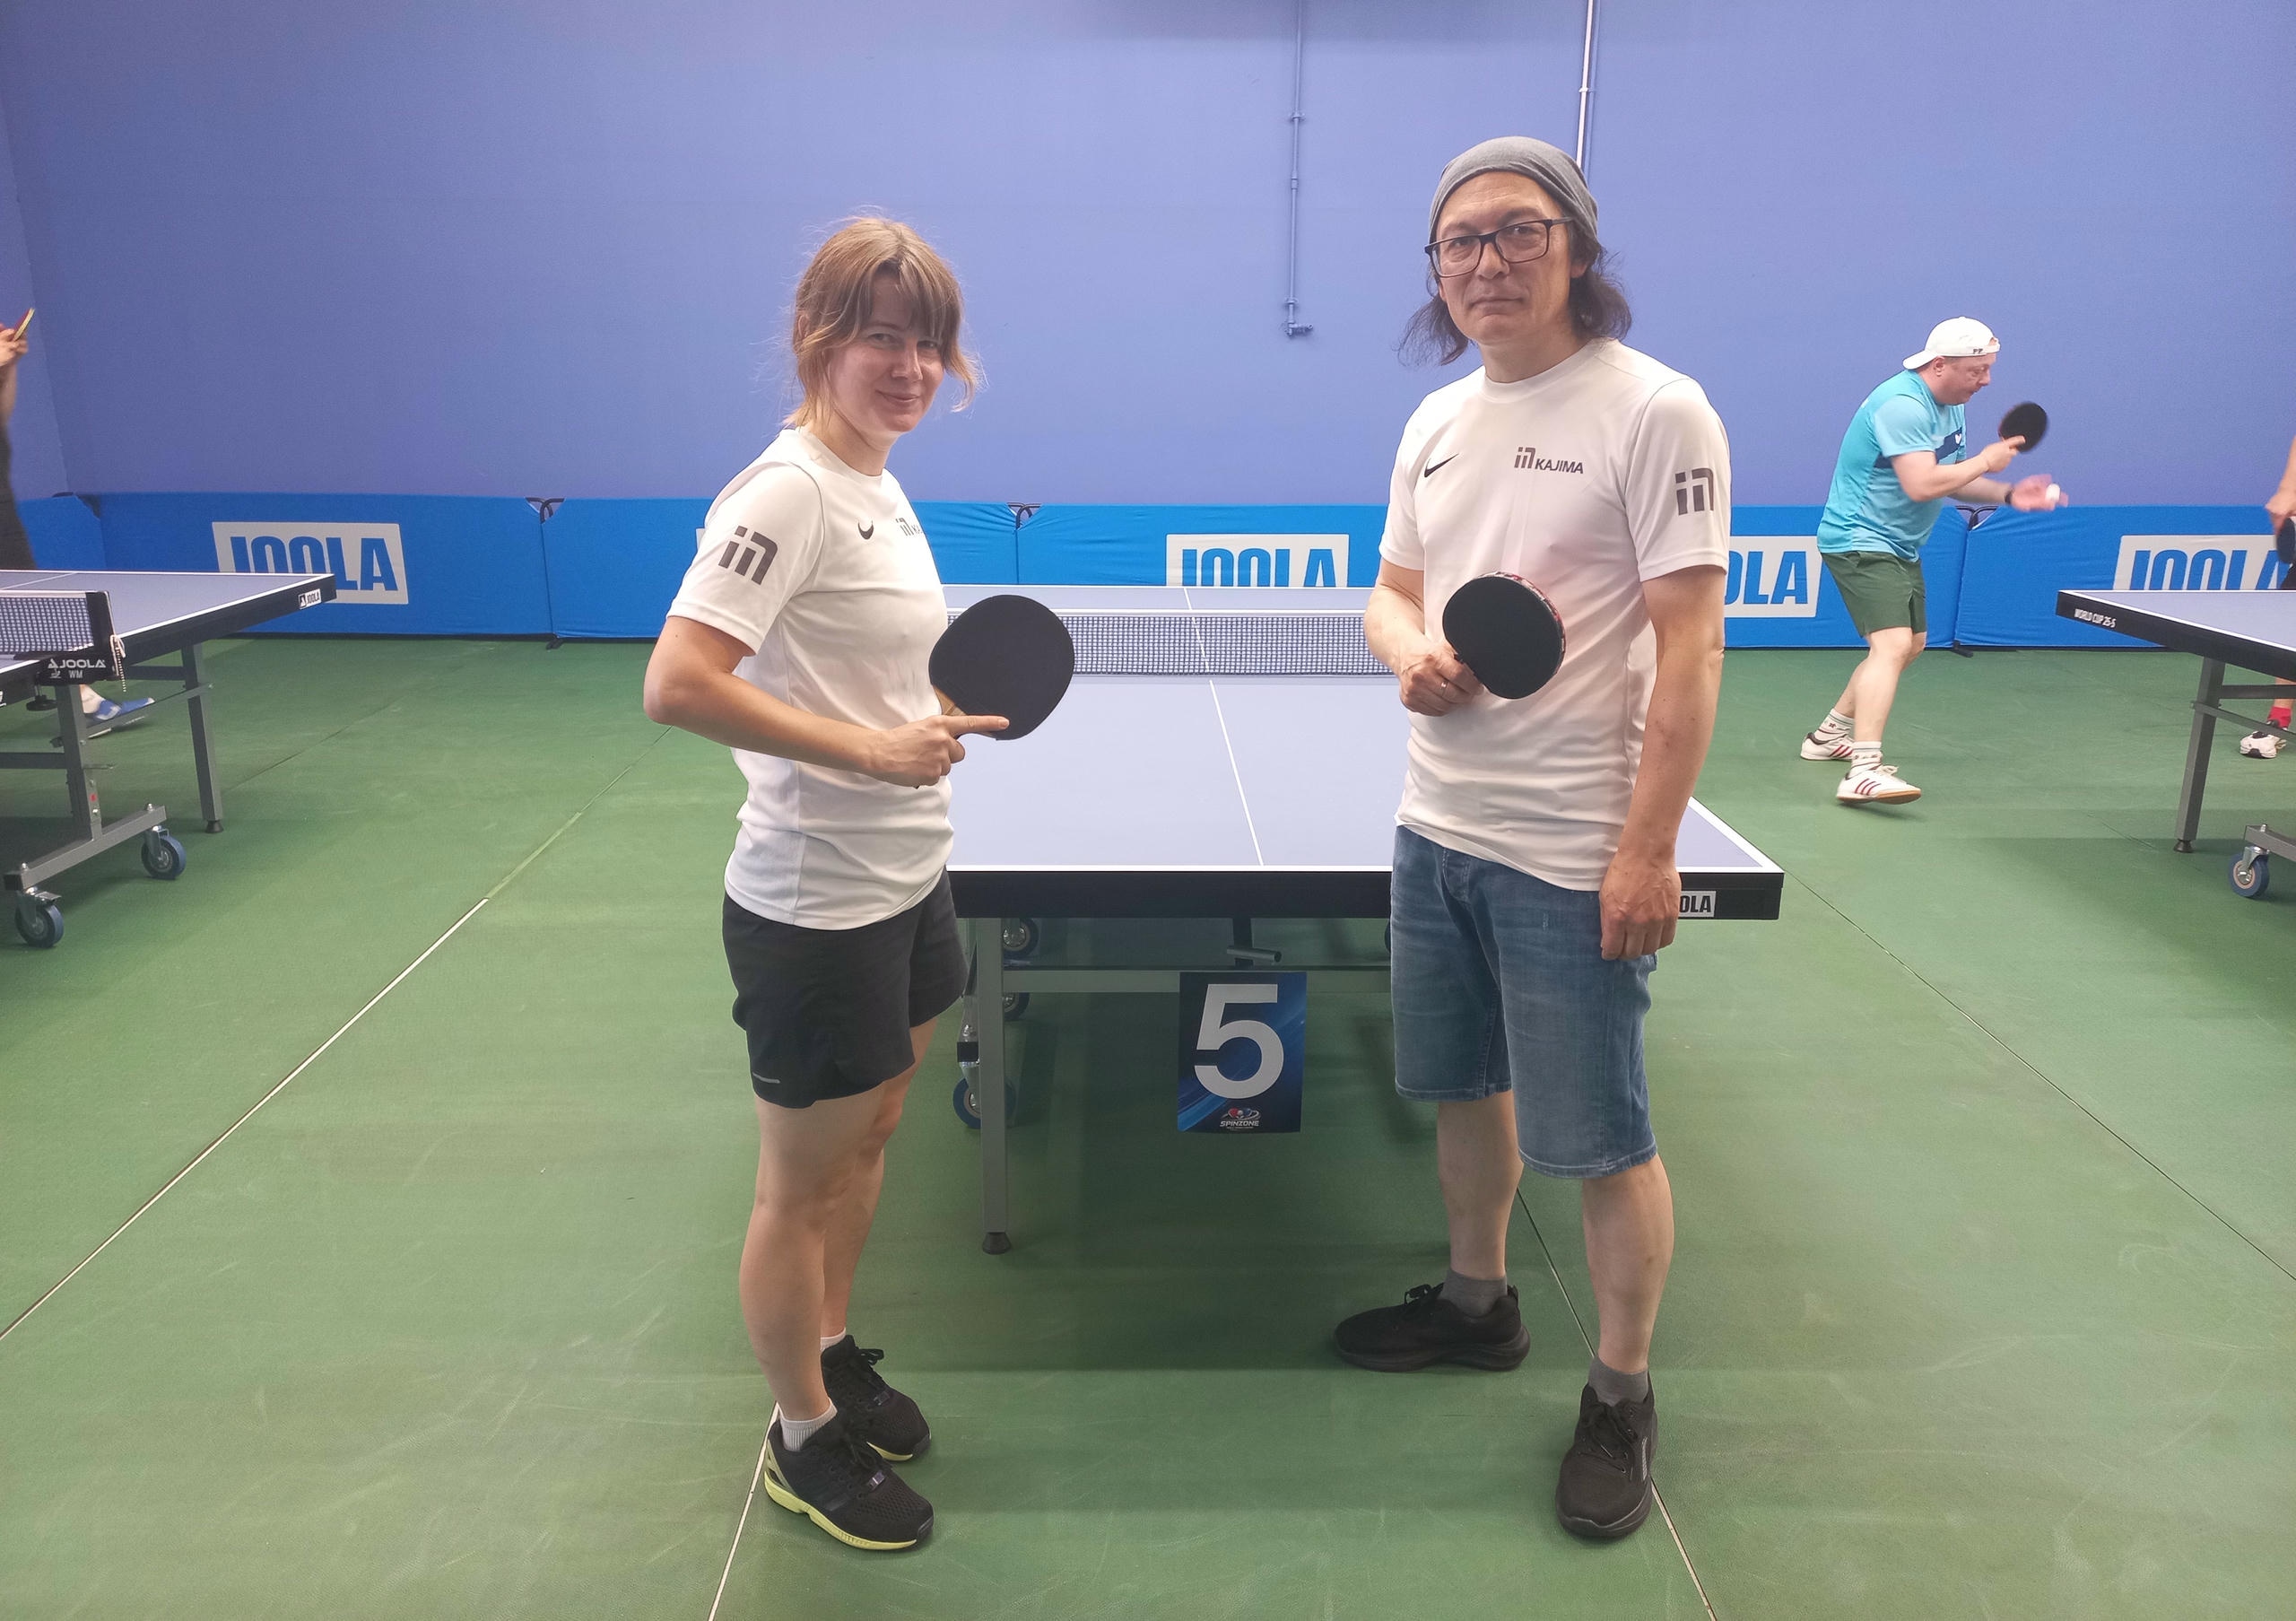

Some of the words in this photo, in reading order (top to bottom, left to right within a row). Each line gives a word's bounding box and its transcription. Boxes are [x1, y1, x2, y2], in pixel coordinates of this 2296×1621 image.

[1535, 458, 1584, 474] KAJIMA
[59, 658, 106, 668] JOOLA
[68, 669, 83, 678] WM
[1679, 895, 1711, 913] OLA
[1194, 983, 1284, 1099] 5
